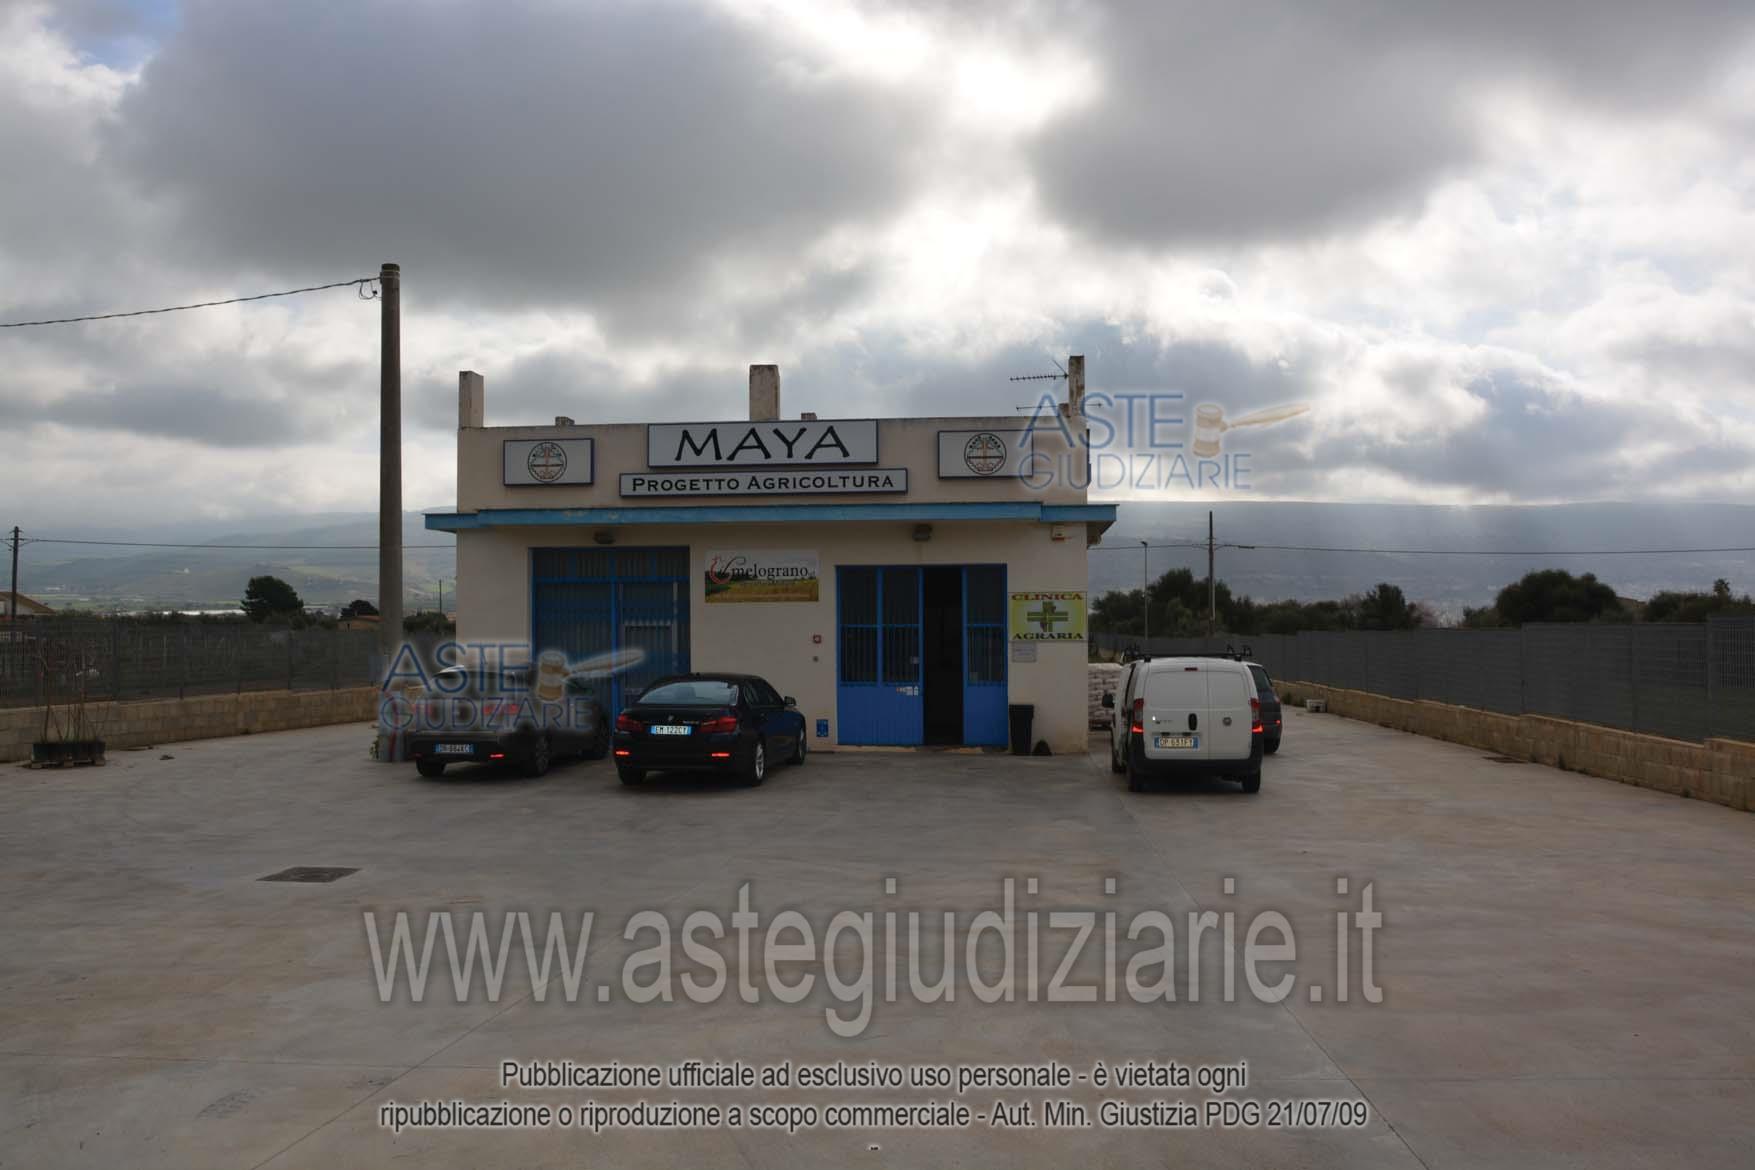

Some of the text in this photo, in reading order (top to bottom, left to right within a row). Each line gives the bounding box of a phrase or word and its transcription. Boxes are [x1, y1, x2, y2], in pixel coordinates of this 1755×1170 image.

[674, 425, 850, 462] MAYA
[731, 563, 809, 581] melograno
[1011, 593, 1083, 601] CLINICA
[1012, 632, 1084, 640] AGRARIA
